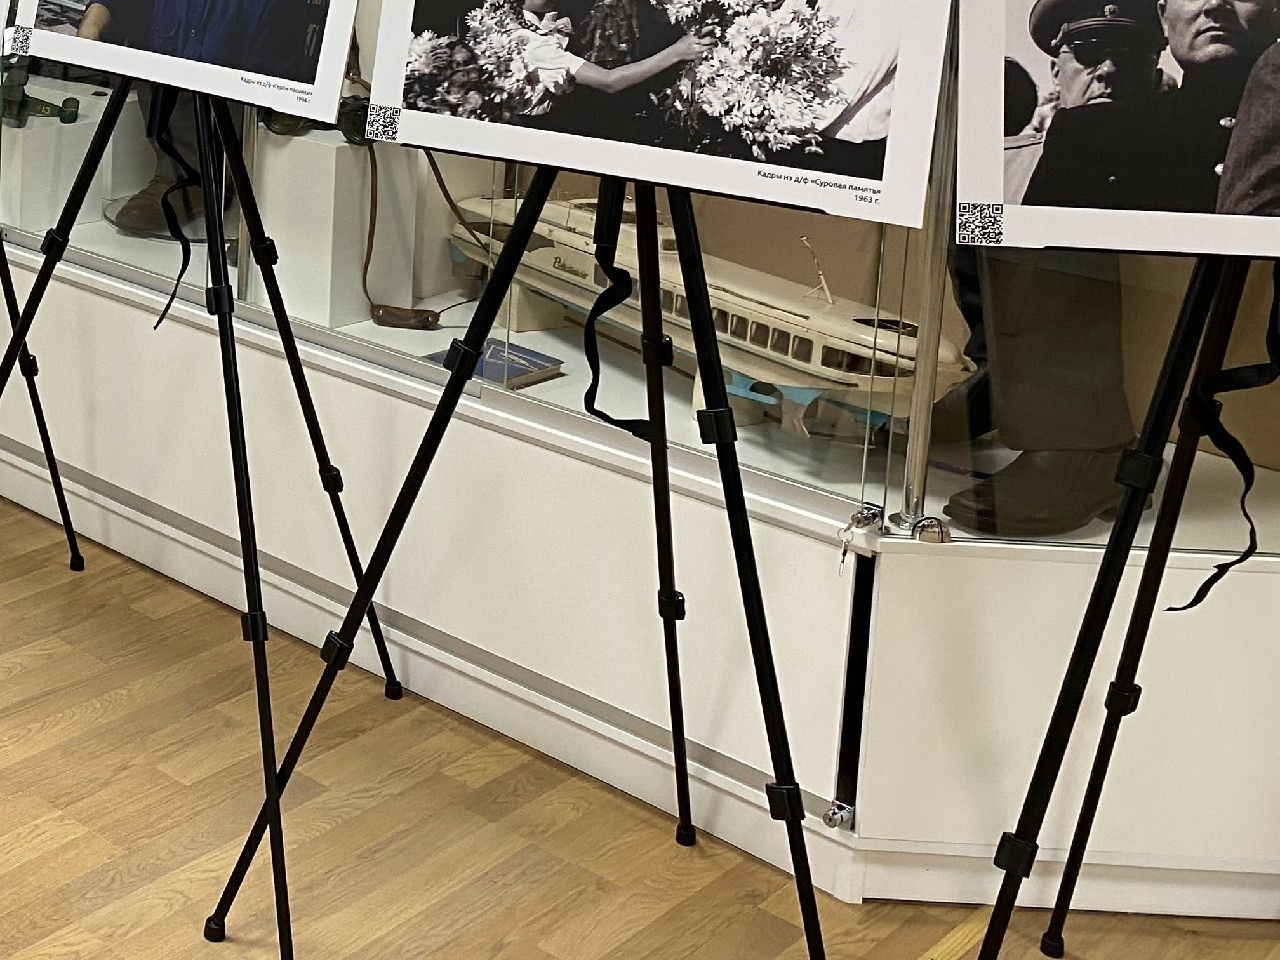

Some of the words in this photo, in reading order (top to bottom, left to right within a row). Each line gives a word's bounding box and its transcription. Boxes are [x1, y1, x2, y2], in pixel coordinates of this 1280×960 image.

[757, 169, 783, 180] Кадры
[783, 174, 793, 182] из
[793, 175, 810, 186] д/ф
[810, 178, 847, 190] «Суровая
[847, 183, 882, 195] память»
[853, 194, 873, 204] 1963
